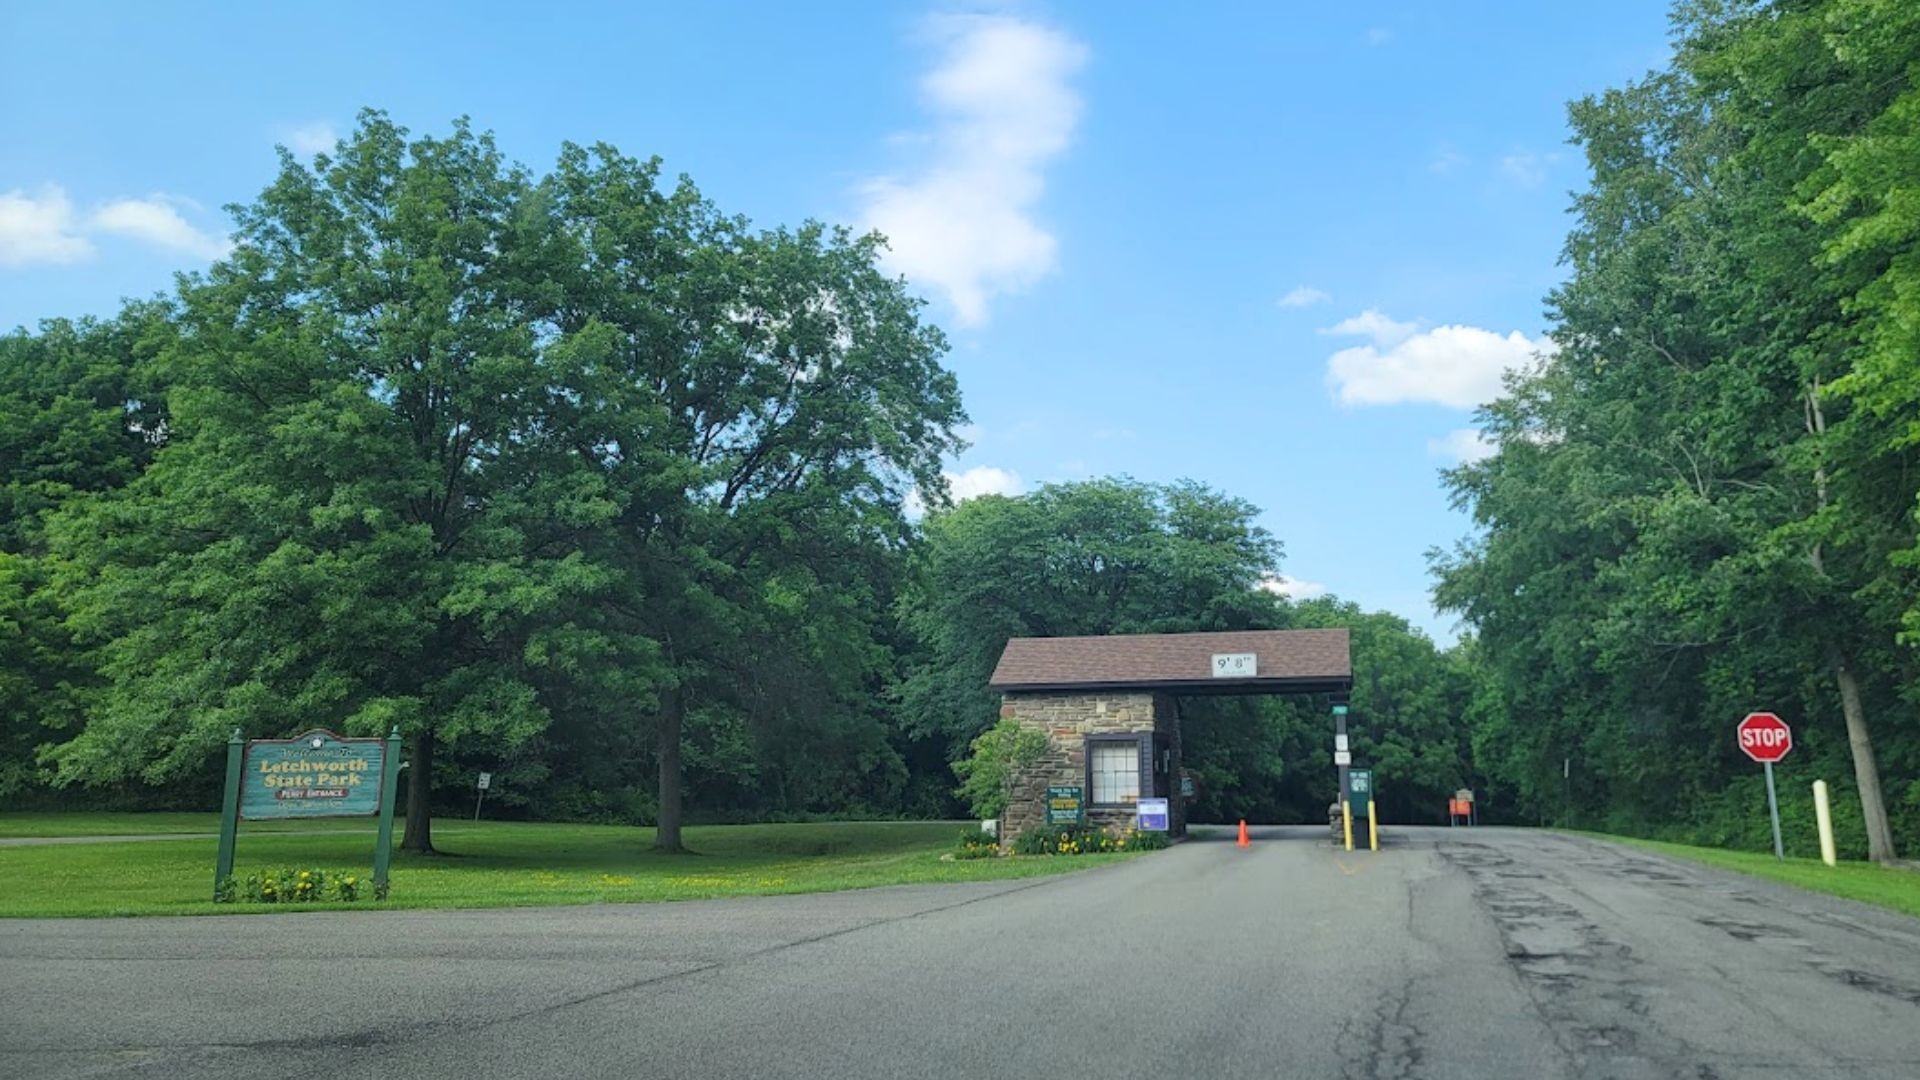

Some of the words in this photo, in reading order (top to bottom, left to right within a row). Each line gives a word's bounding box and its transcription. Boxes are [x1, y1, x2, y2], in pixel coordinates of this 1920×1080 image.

[1742, 727, 1786, 747] STOP
[260, 759, 368, 773] Letchworth
[264, 774, 312, 787] State
[317, 773, 361, 786] Park
